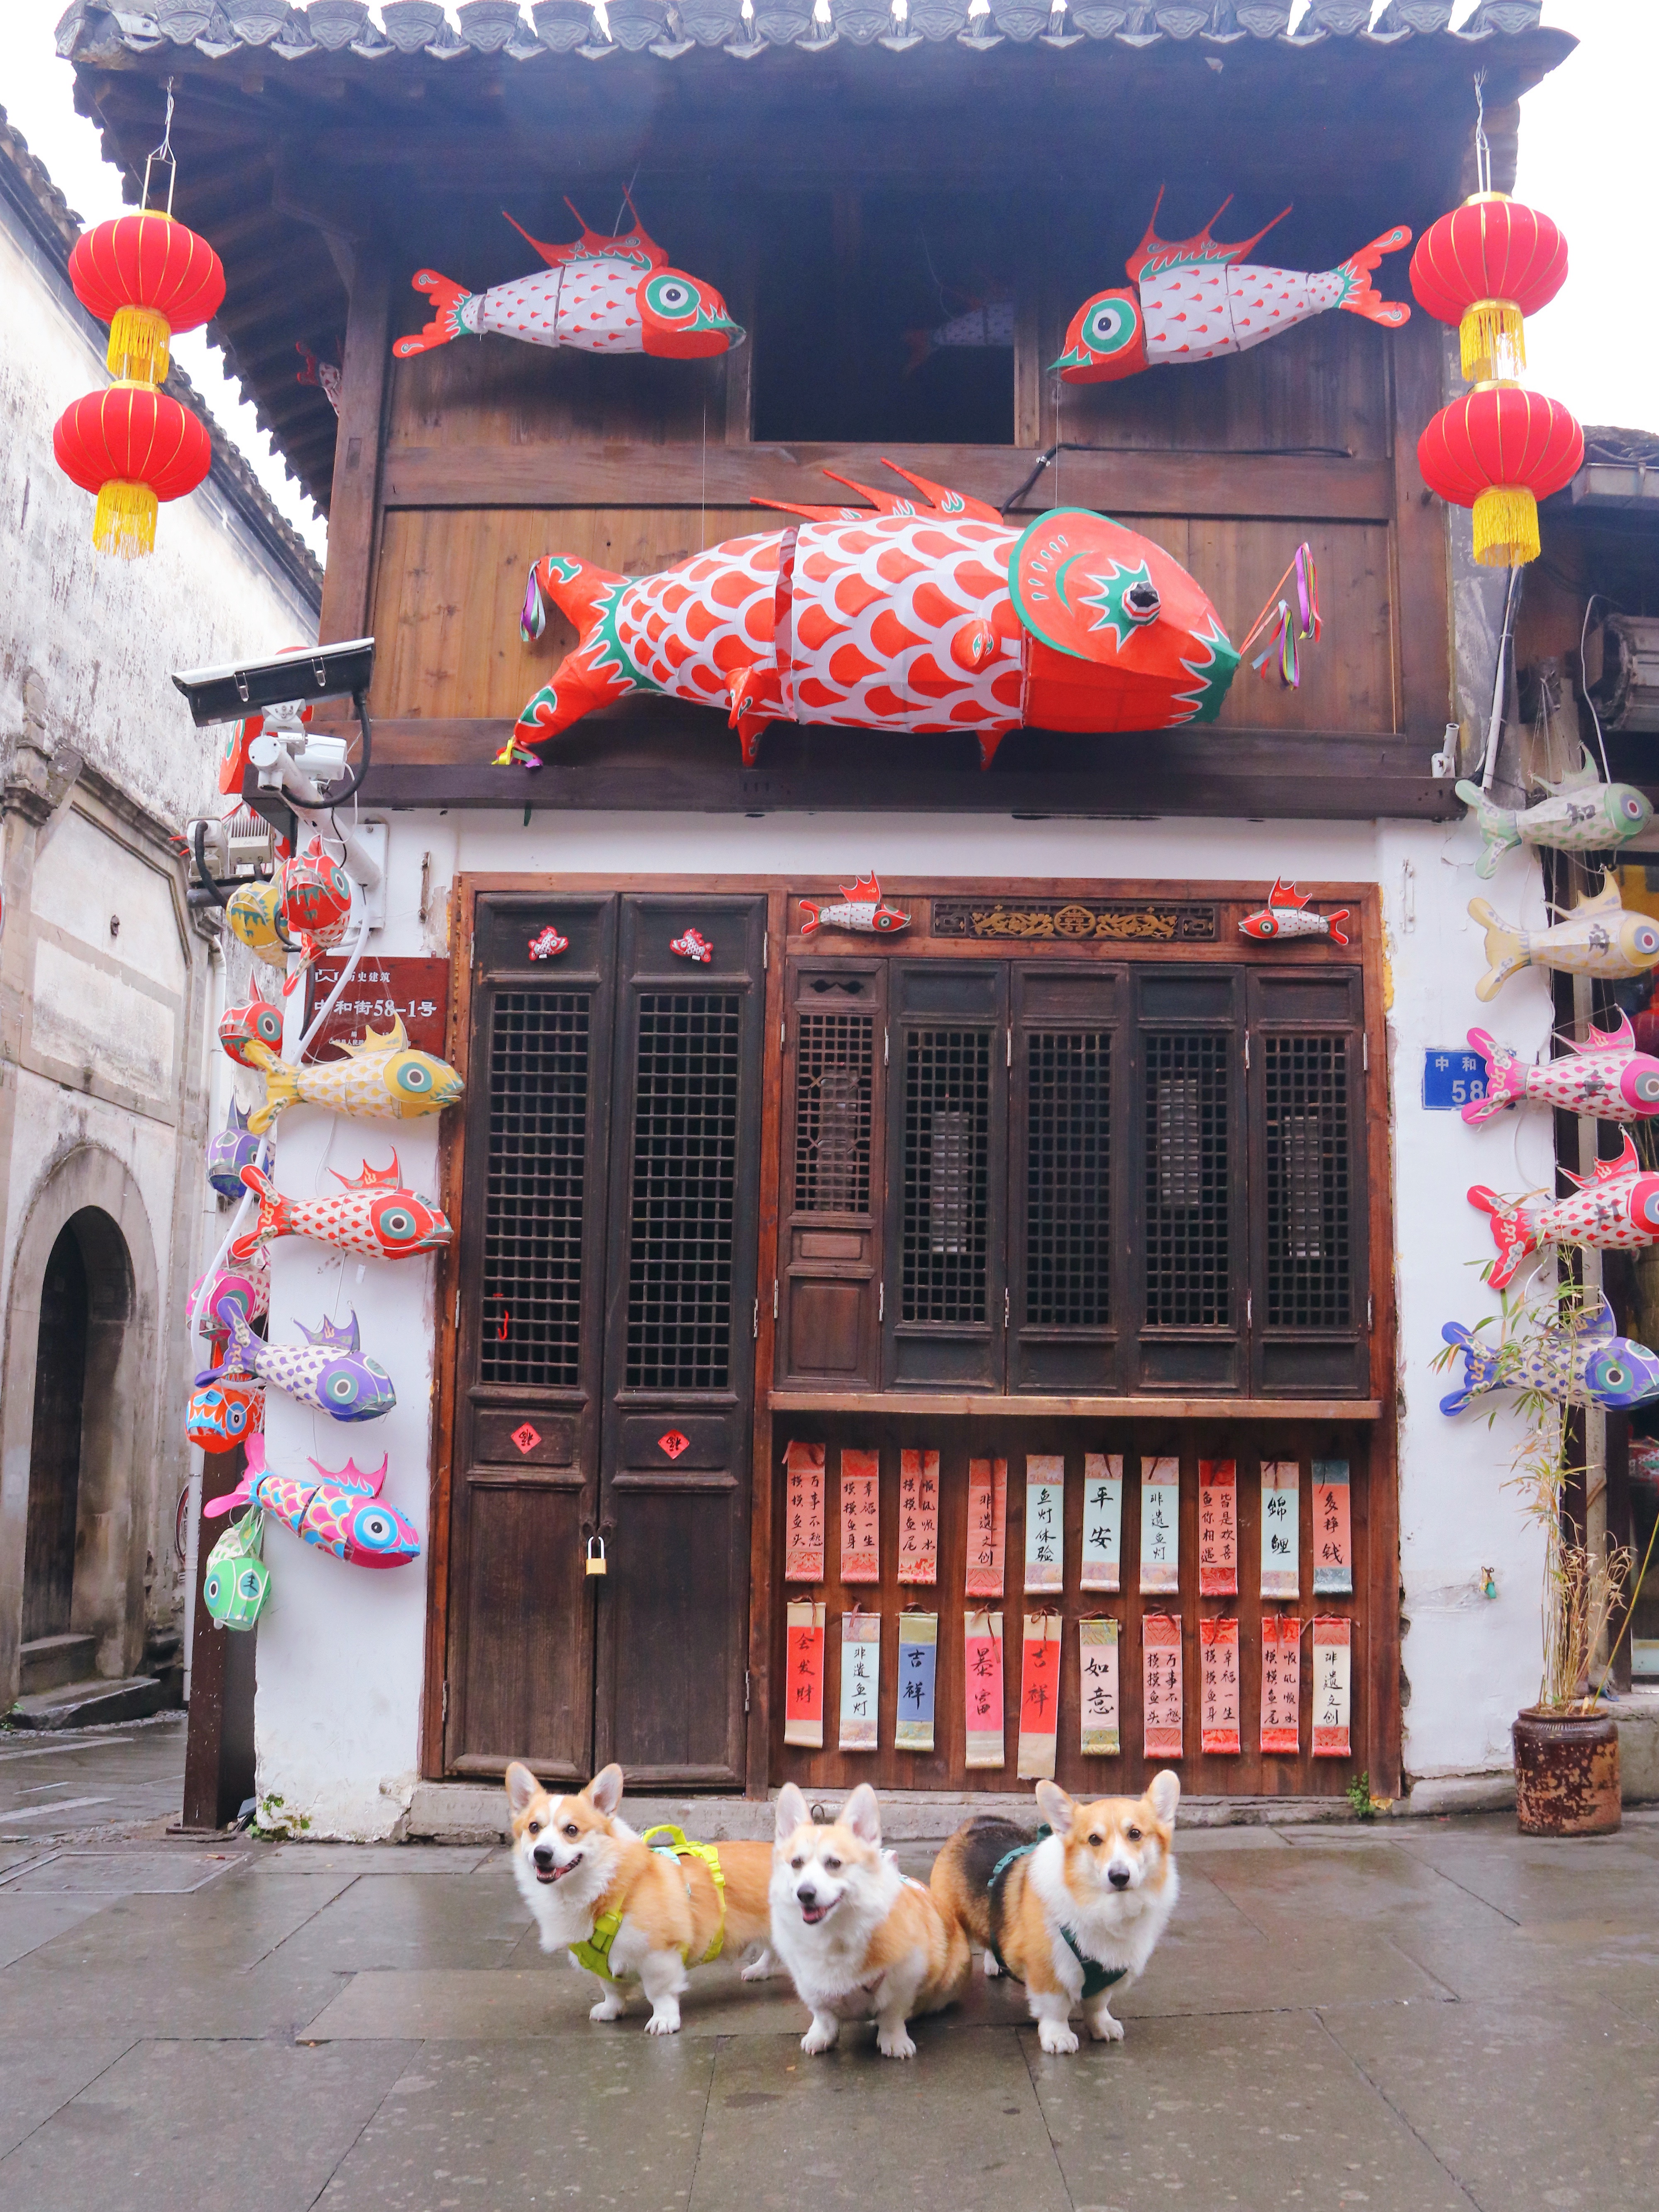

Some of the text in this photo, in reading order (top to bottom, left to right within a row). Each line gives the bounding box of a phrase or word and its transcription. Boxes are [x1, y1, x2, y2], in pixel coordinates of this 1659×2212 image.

[314, 998, 437, 1018] 中和街58-1号
[1435, 1056, 1476, 1072] 中和
[1452, 1080, 1484, 1103] 58
[809, 1475, 823, 1547] 万事不愁
[860, 1481, 876, 1547] 幸福一生
[922, 1480, 936, 1550] 顺风顺水
[978, 1493, 997, 1566] 非遗文创
[1089, 1486, 1114, 1550] 平安
[1150, 1491, 1169, 1561] 非遗鱼灯
[1201, 1491, 1217, 1564] 鱼你相遇
[1219, 1493, 1235, 1560] 皆是欢喜
[1267, 1497, 1291, 1555] 锦鲤
[1322, 1491, 1344, 1564] 多挣钱
[795, 1633, 816, 1703] 会发财
[852, 1646, 870, 1716] 非遗鱼灯
[902, 1649, 926, 1711] 吉祥
[971, 1647, 993, 1715] 暴富
[1025, 1648, 1049, 1718] 吉祥
[1084, 1657, 1115, 1715] 如意
[1147, 1653, 1161, 1725] 摸摸鱼头
[1165, 1653, 1181, 1723] 万事不愁
[1204, 1649, 1217, 1723] 摸摸鱼身
[1221, 1649, 1236, 1720] 幸福一生
[1264, 1649, 1279, 1724] 摸摸鱼尾
[1283, 1650, 1297, 1724] 顺风顺水
[1322, 1650, 1343, 1726] 非遗文创
